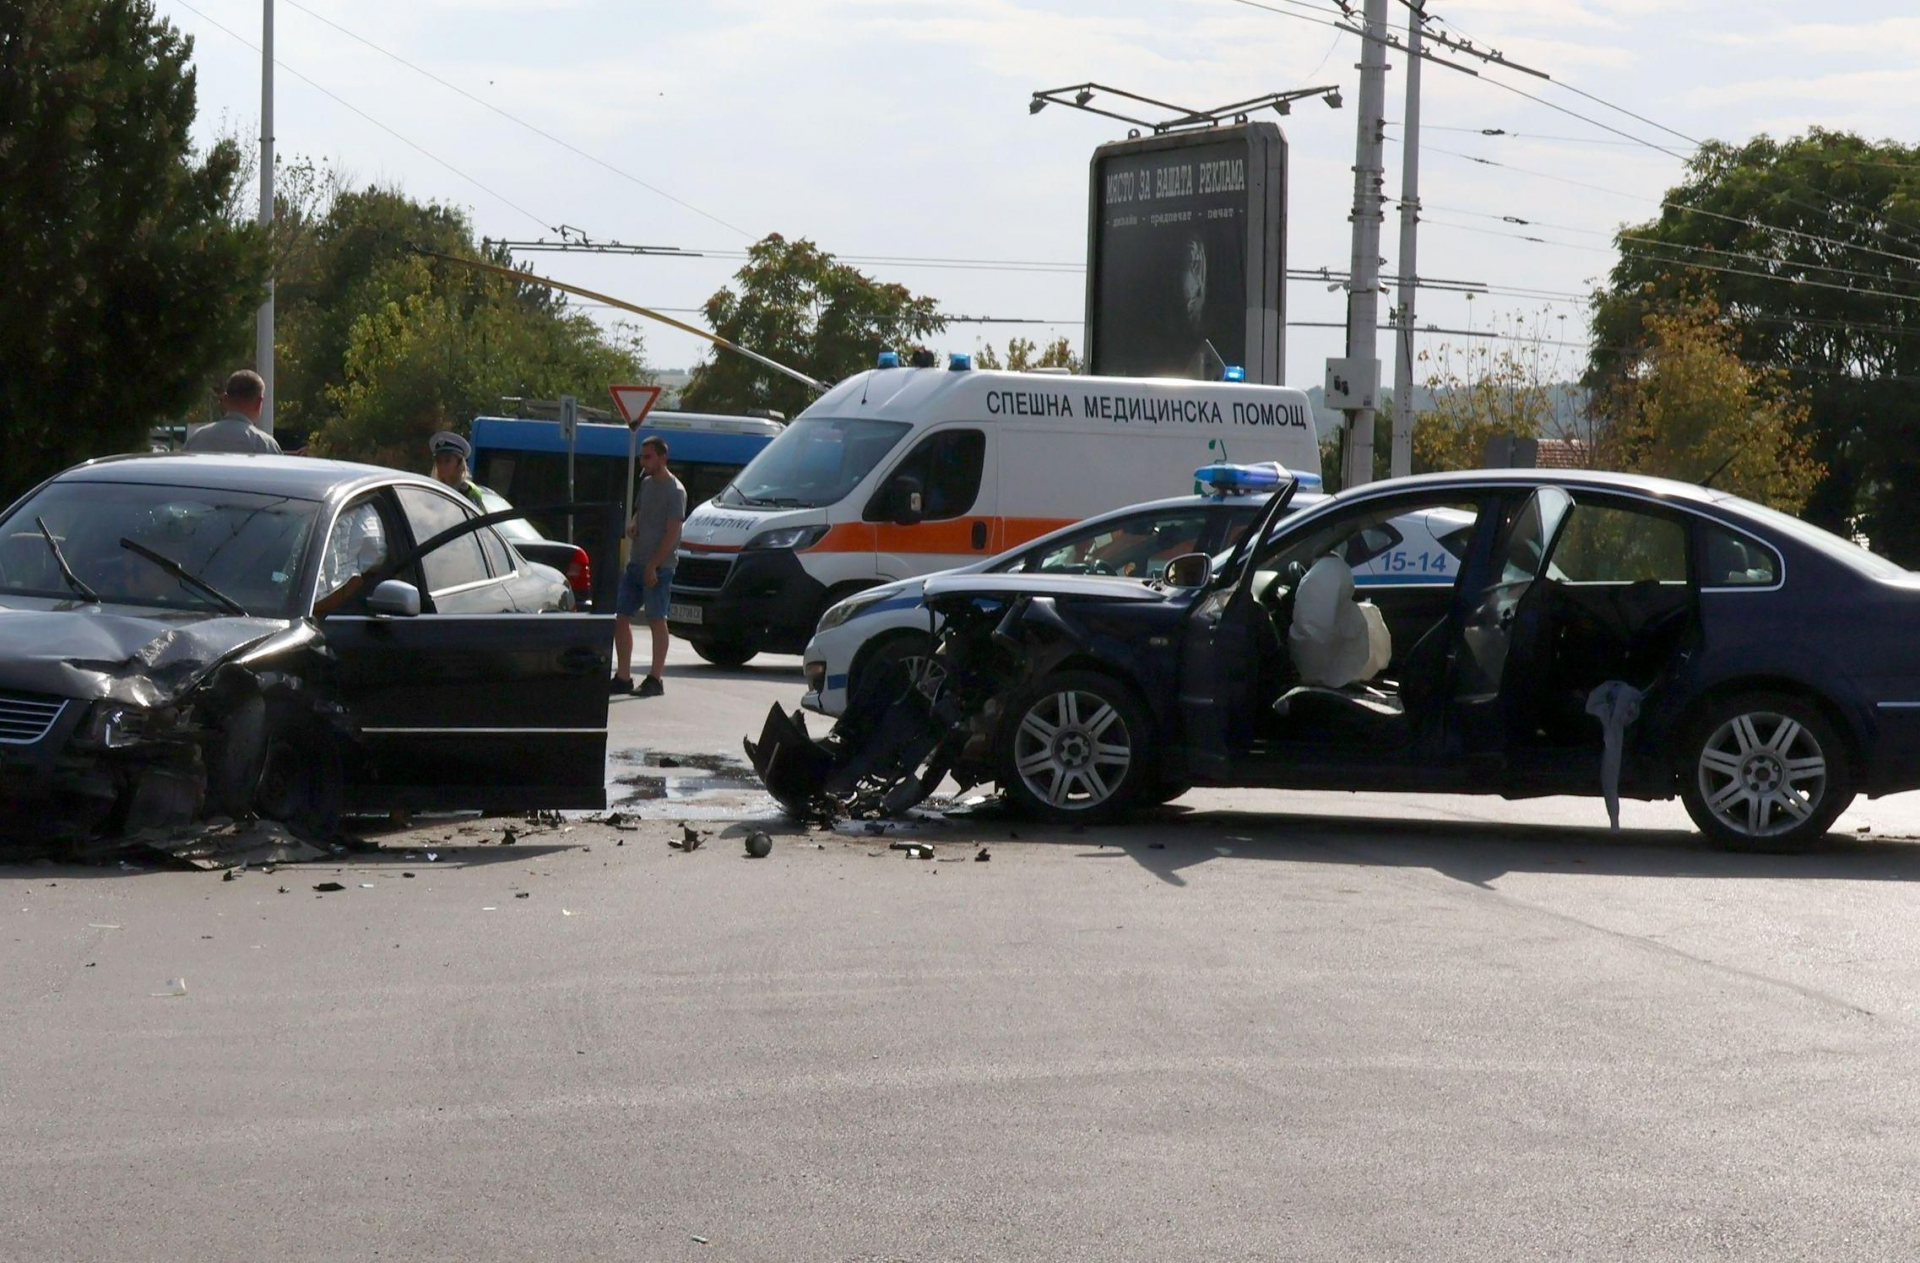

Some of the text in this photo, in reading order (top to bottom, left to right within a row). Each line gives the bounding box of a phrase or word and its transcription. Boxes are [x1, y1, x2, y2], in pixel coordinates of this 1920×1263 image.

[1106, 159, 1245, 205] МЯСТО ЗА ВАШАТА РЕКЛАМА
[1207, 207, 1234, 220] печат
[986, 390, 1307, 430] СПЕШНА МЕДИЦИНСКА ПОМОЩ
[1381, 551, 1446, 572] 15-14
